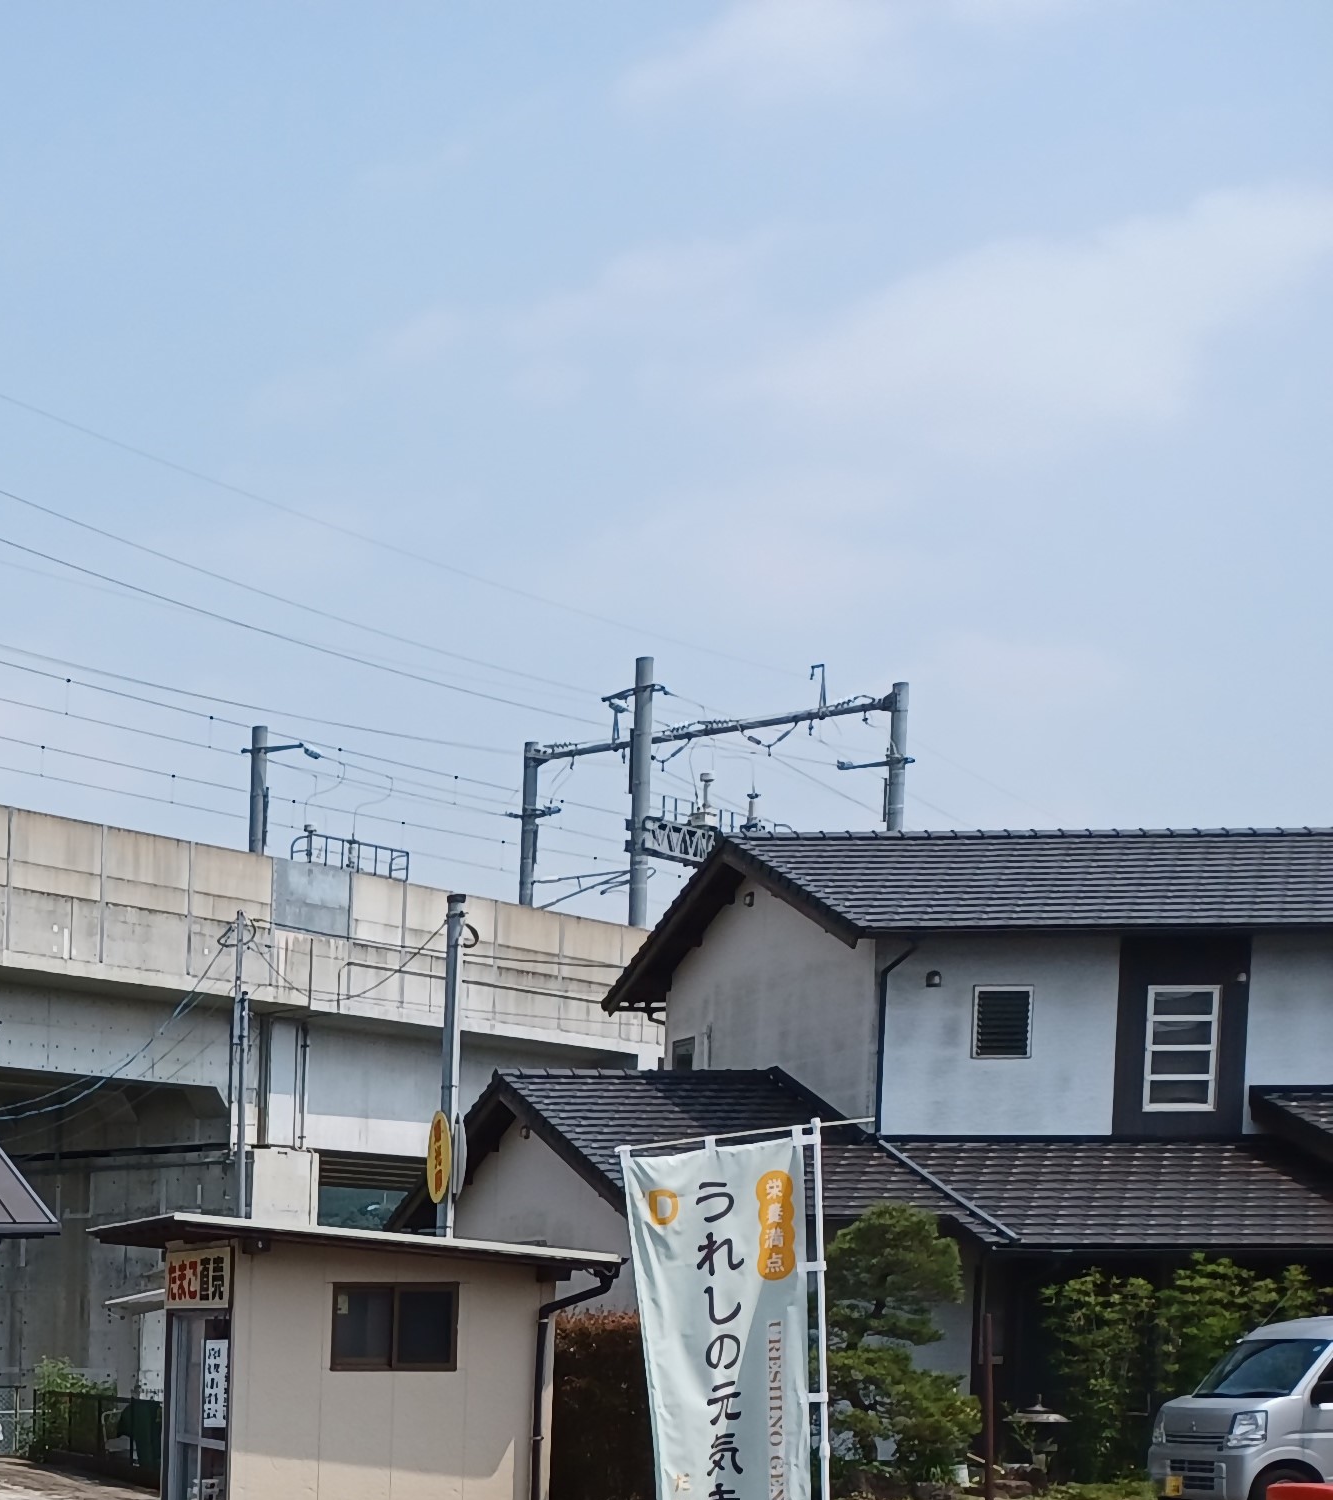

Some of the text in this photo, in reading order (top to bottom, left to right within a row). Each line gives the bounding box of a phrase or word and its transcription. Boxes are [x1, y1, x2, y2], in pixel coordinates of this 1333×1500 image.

[764, 1178, 785, 1273] 栄養満点
[167, 1255, 225, 1301] たまご直売
[768, 1320, 783, 1447] URESHINO
